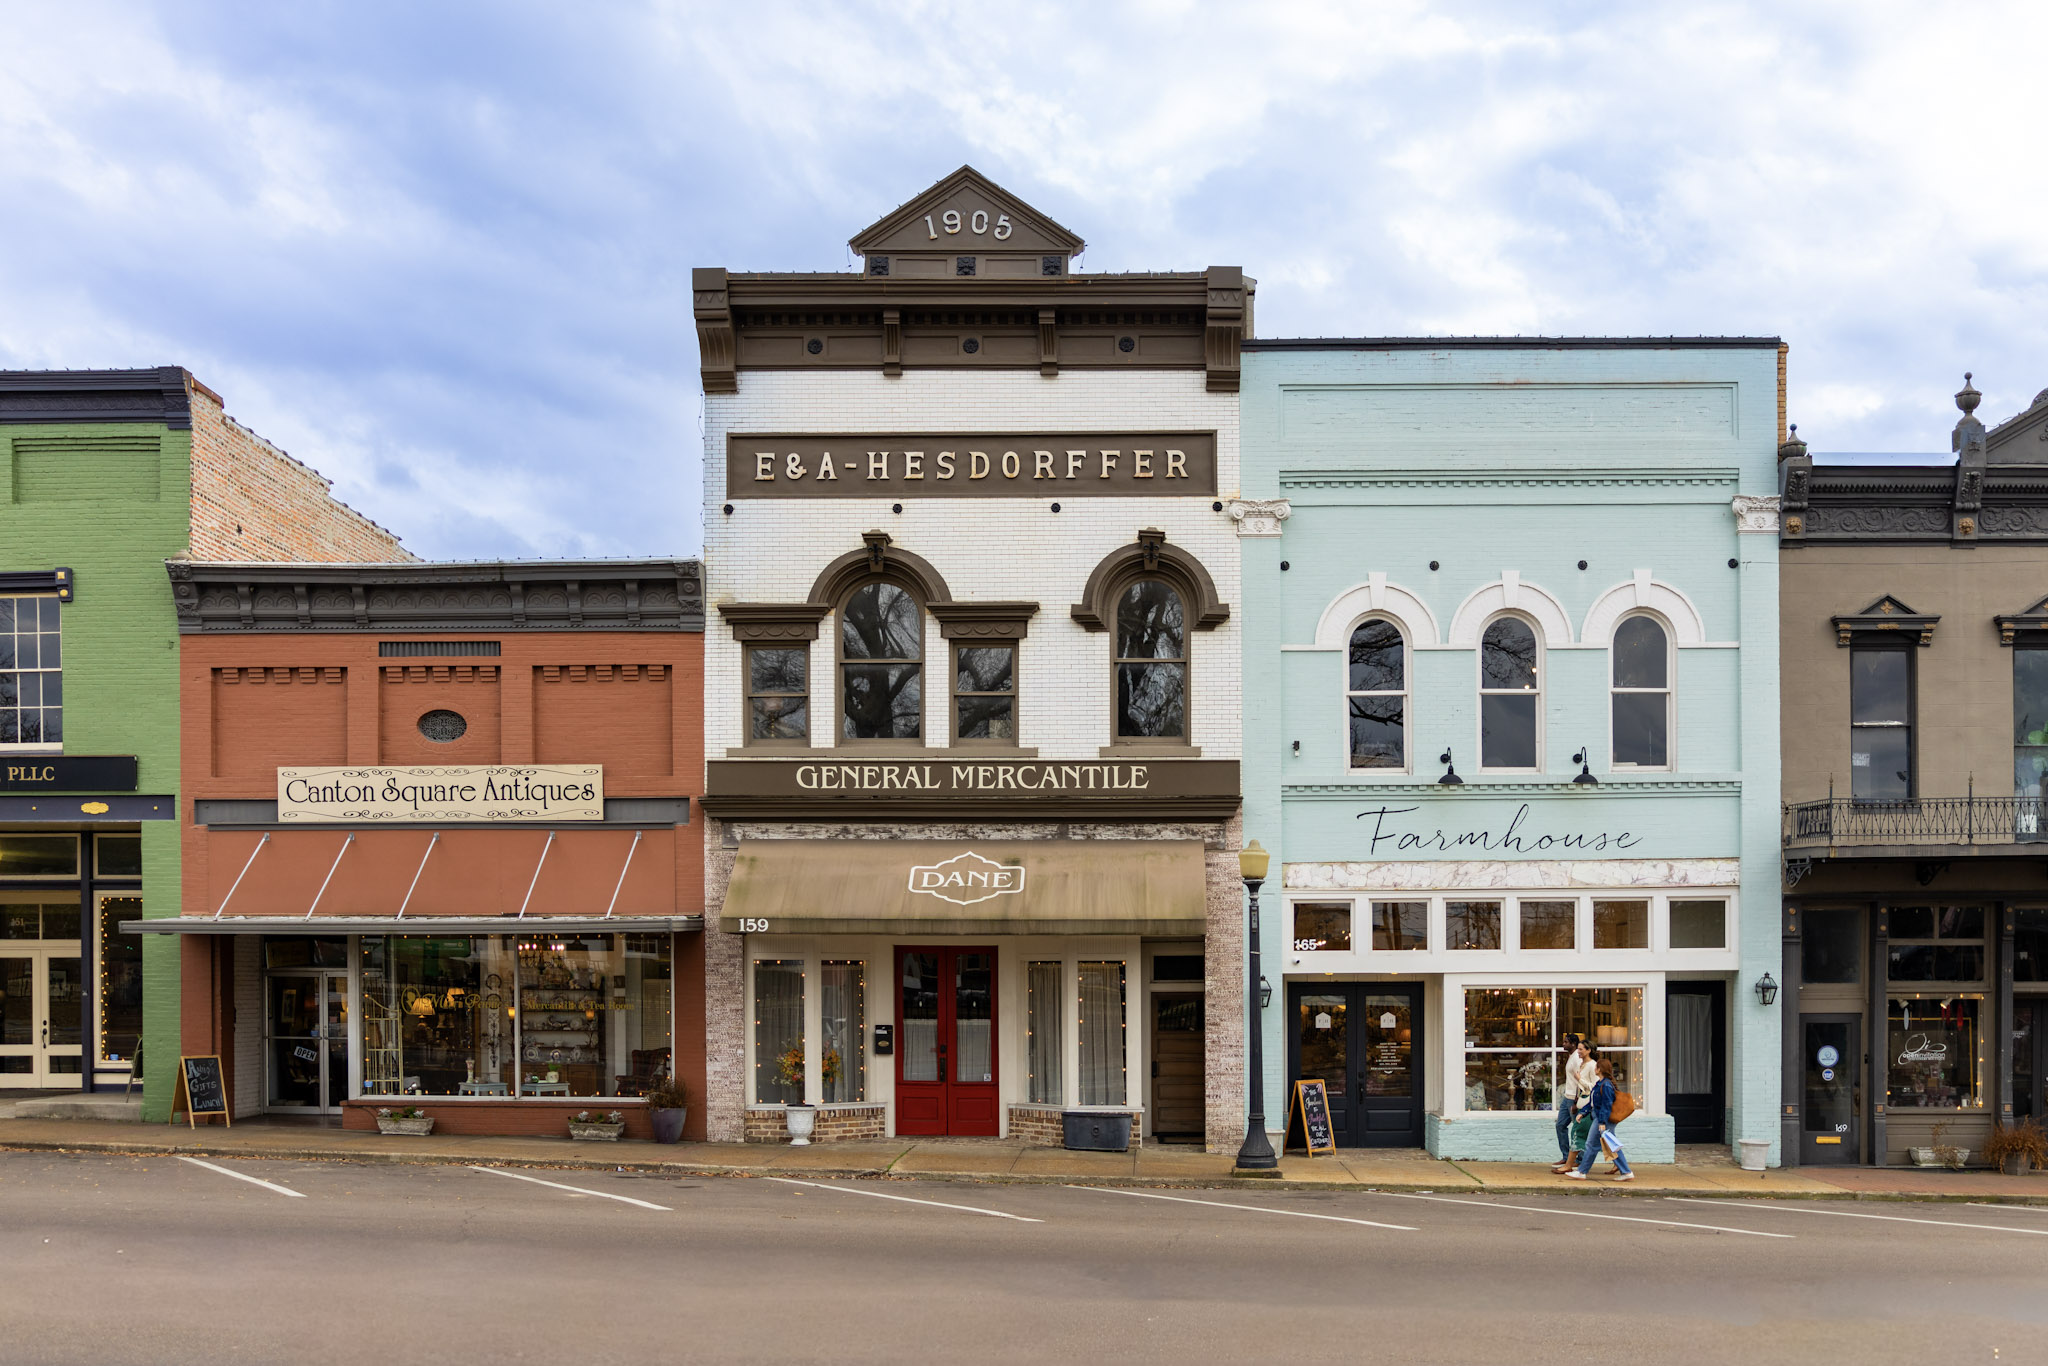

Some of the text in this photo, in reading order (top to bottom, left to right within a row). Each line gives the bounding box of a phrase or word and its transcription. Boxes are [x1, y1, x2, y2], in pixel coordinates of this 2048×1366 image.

[924, 209, 1013, 241] 1905
[8, 766, 55, 781] PLLC
[795, 765, 1151, 790] GENERAL MERCANTILE
[286, 776, 596, 811] Canton Square Antiques
[1356, 803, 1644, 856] Farmhouse
[920, 870, 1014, 888] DANE
[738, 917, 769, 932] 159
[1294, 938, 1317, 951] 165
[589, 1000, 605, 1010] Tea
[296, 1047, 316, 1060] OPEN
[1835, 1123, 1848, 1133] 169
